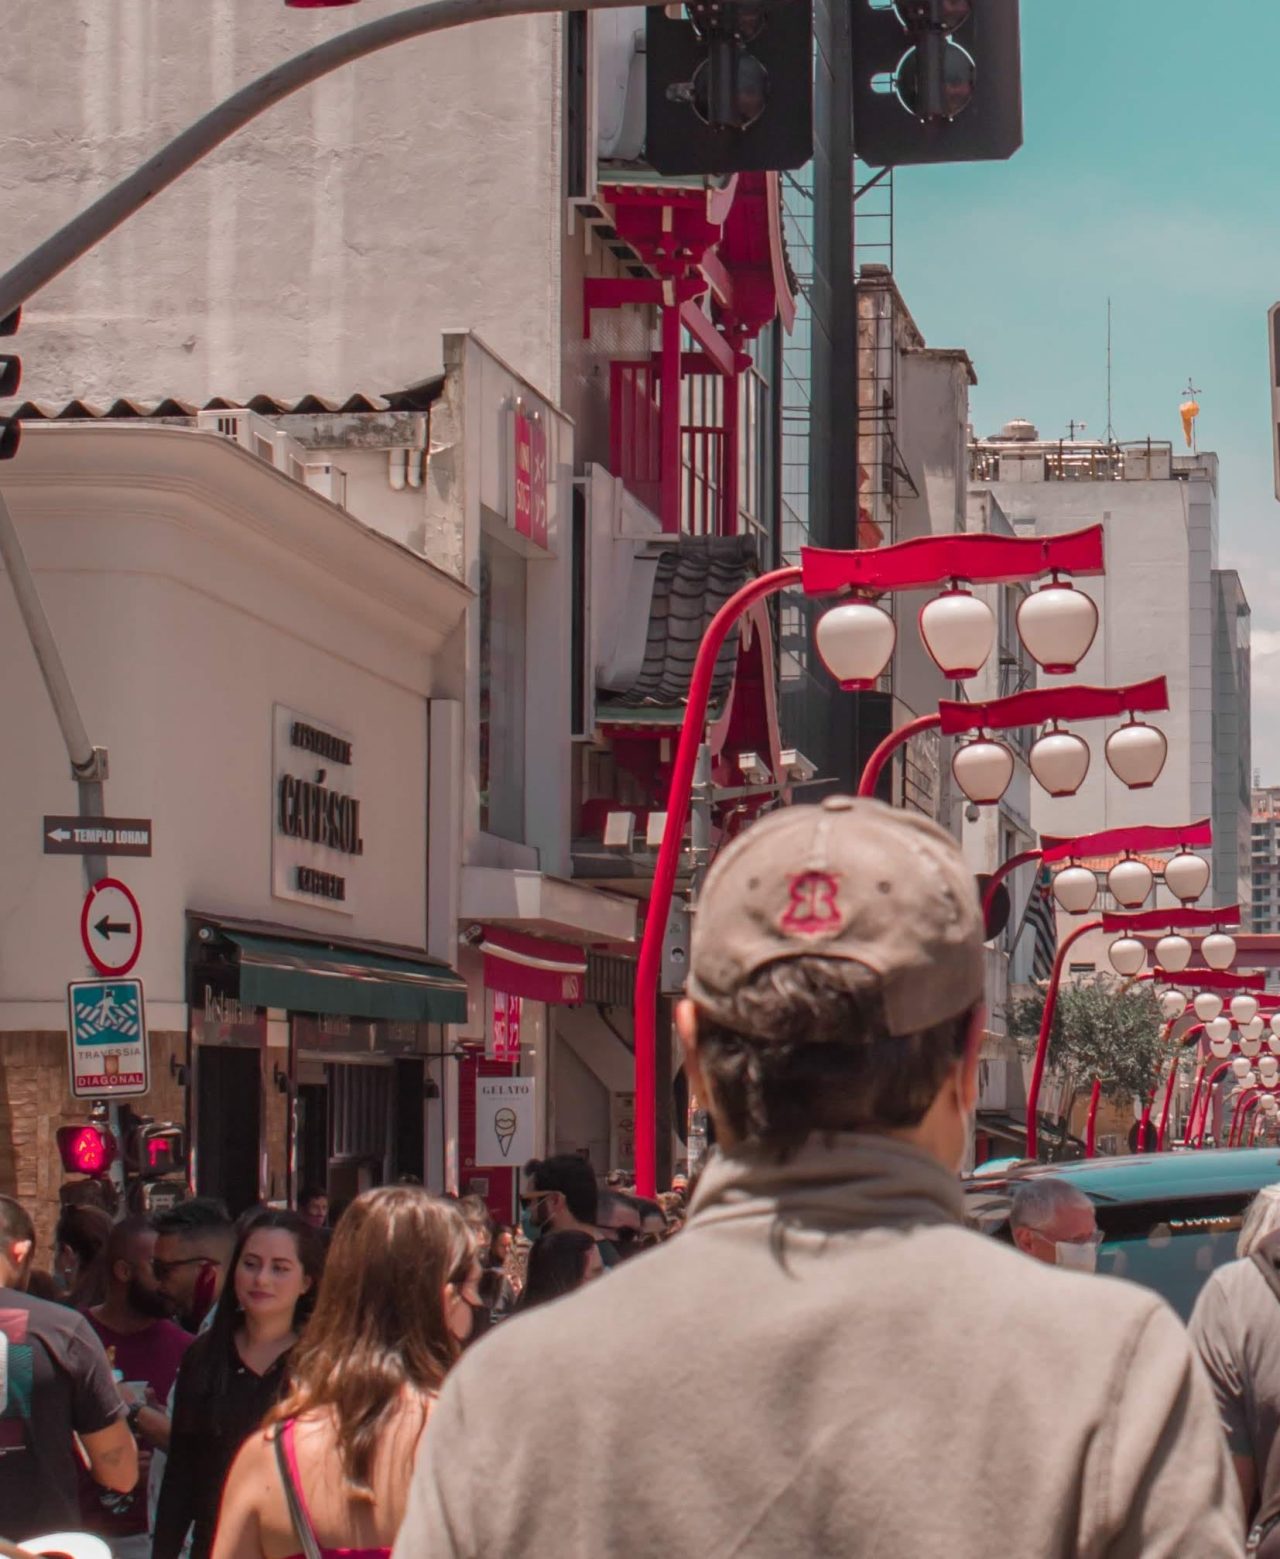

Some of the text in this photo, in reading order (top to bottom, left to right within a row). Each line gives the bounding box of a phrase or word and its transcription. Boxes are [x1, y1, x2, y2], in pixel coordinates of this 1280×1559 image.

[73, 828, 149, 845] TEMPLO LOHAN
[77, 1048, 141, 1060] TRAVESSIA
[78, 1074, 143, 1087] DIAGONAL
[481, 1085, 530, 1096] GELATO
